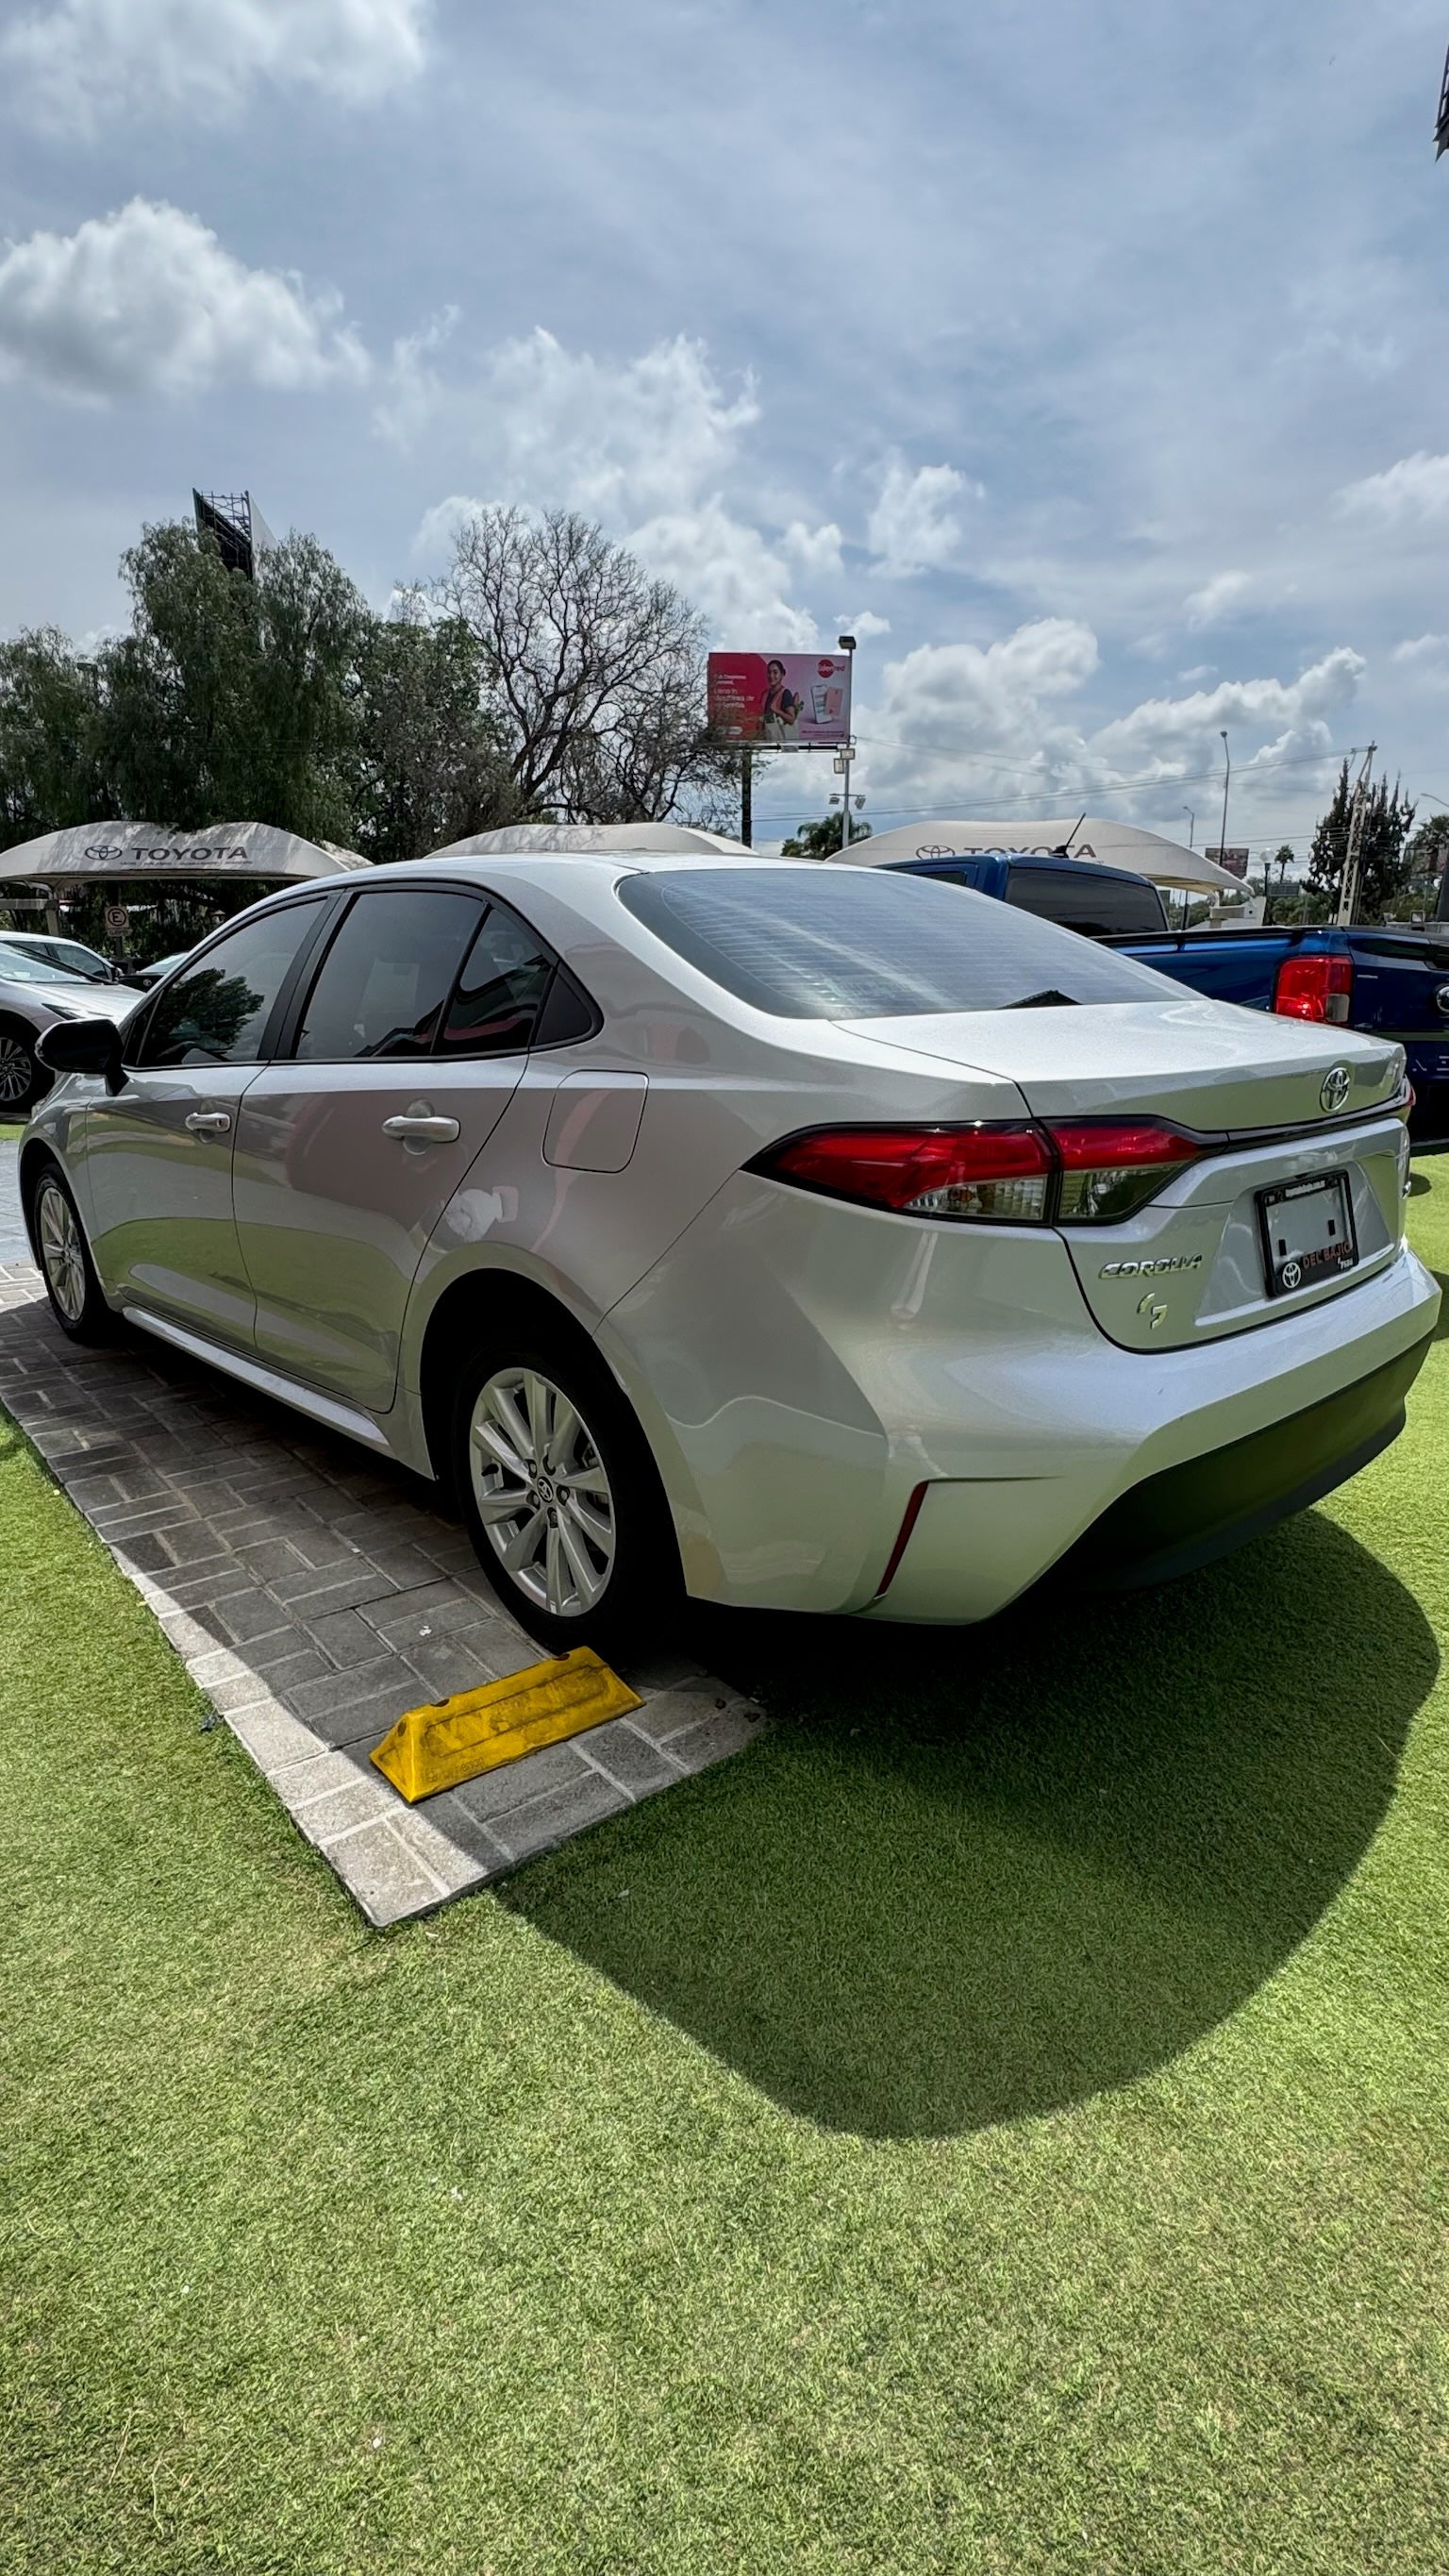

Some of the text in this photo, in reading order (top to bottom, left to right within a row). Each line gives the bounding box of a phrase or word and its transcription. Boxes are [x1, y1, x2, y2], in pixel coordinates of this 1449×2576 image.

[131, 846, 248, 861] TOYOTA
[964, 844, 1096, 859] TOYOA
[112, 912, 123, 923] E
[1098, 1253, 1203, 1279] COROLLA
[1303, 1252, 1323, 1269] DEL
